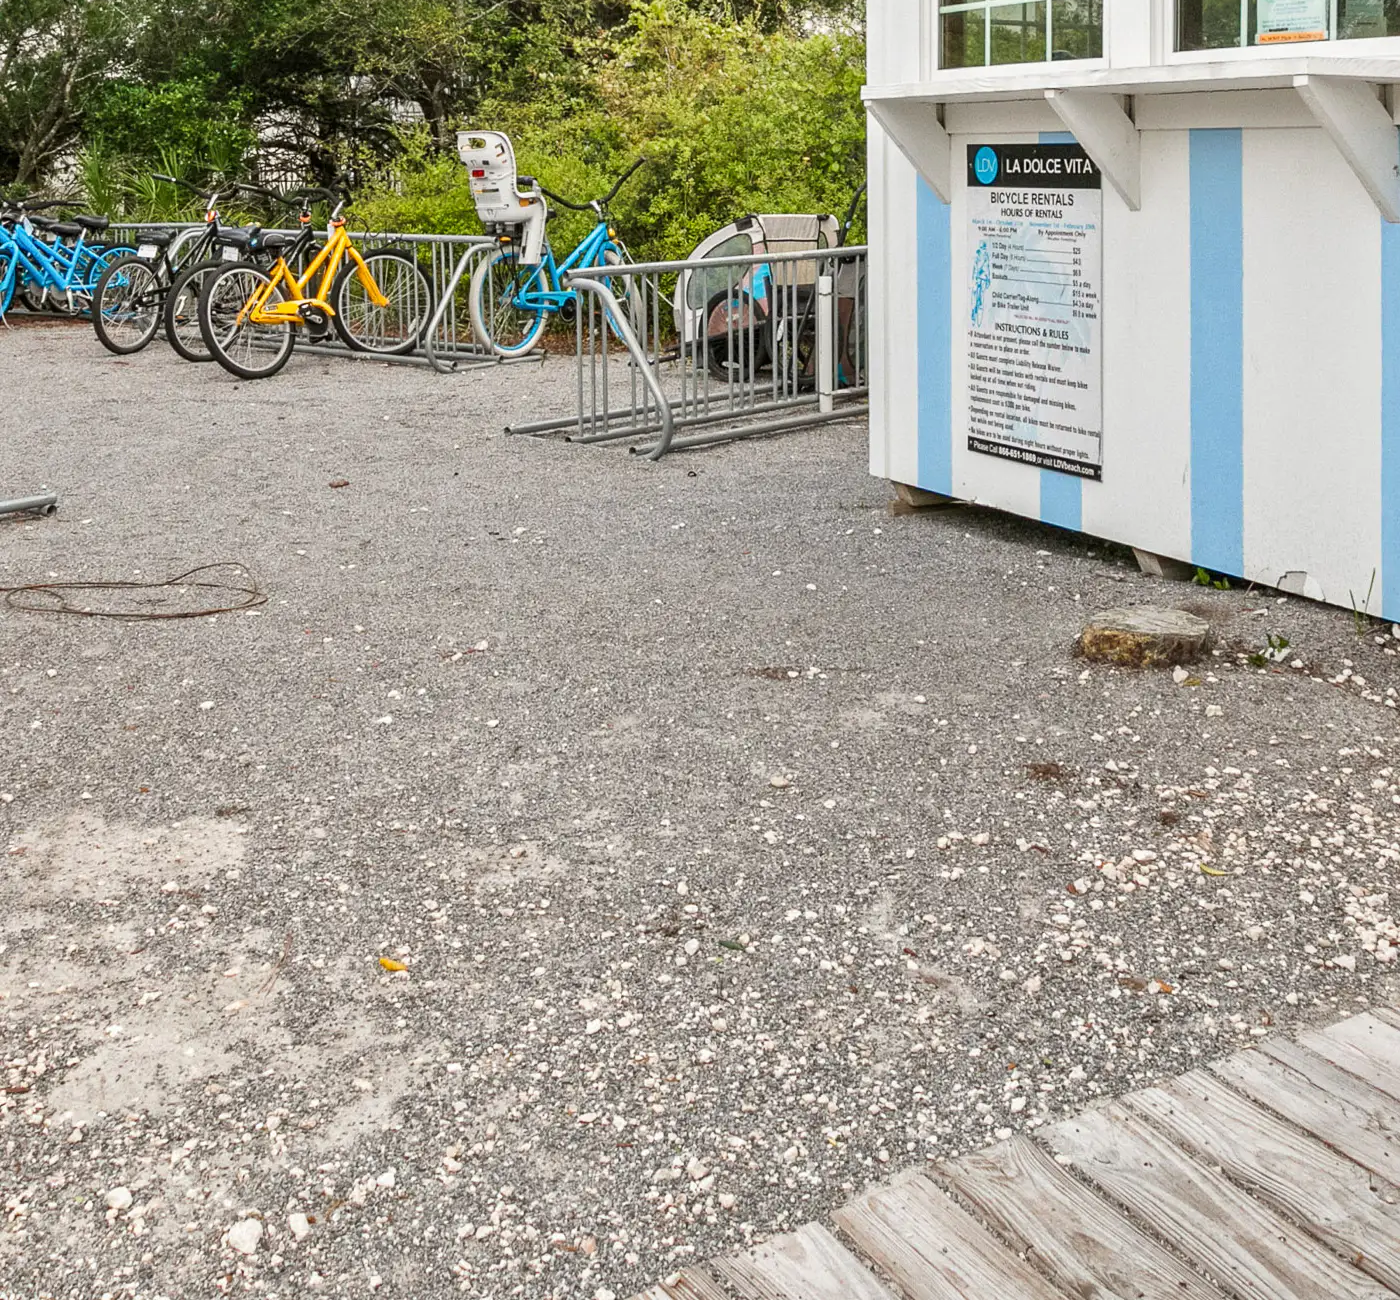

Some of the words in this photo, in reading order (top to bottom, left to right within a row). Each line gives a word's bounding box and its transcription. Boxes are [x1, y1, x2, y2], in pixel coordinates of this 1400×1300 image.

[977, 158, 997, 173] LDV
[1006, 159, 1020, 174] LA
[1024, 159, 1062, 174] DOLCE
[1064, 159, 1093, 174] VITA
[990, 192, 1029, 204] BICYCLE
[1032, 193, 1074, 206] RENTALS
[1001, 208, 1022, 218] HOURS
[1025, 209, 1033, 218] OF
[1035, 210, 1063, 219] RENTALS
[1086, 302, 1094, 311] day
[995, 322, 1040, 336] INSTRUCTIONS
[1042, 328, 1048, 338] &
[1049, 330, 1068, 340] RULES
[974, 440, 988, 452] Please
[990, 444, 998, 454] Call
[1042, 457, 1052, 466] visit
[1054, 458, 1094, 476] LDVbeach.com
